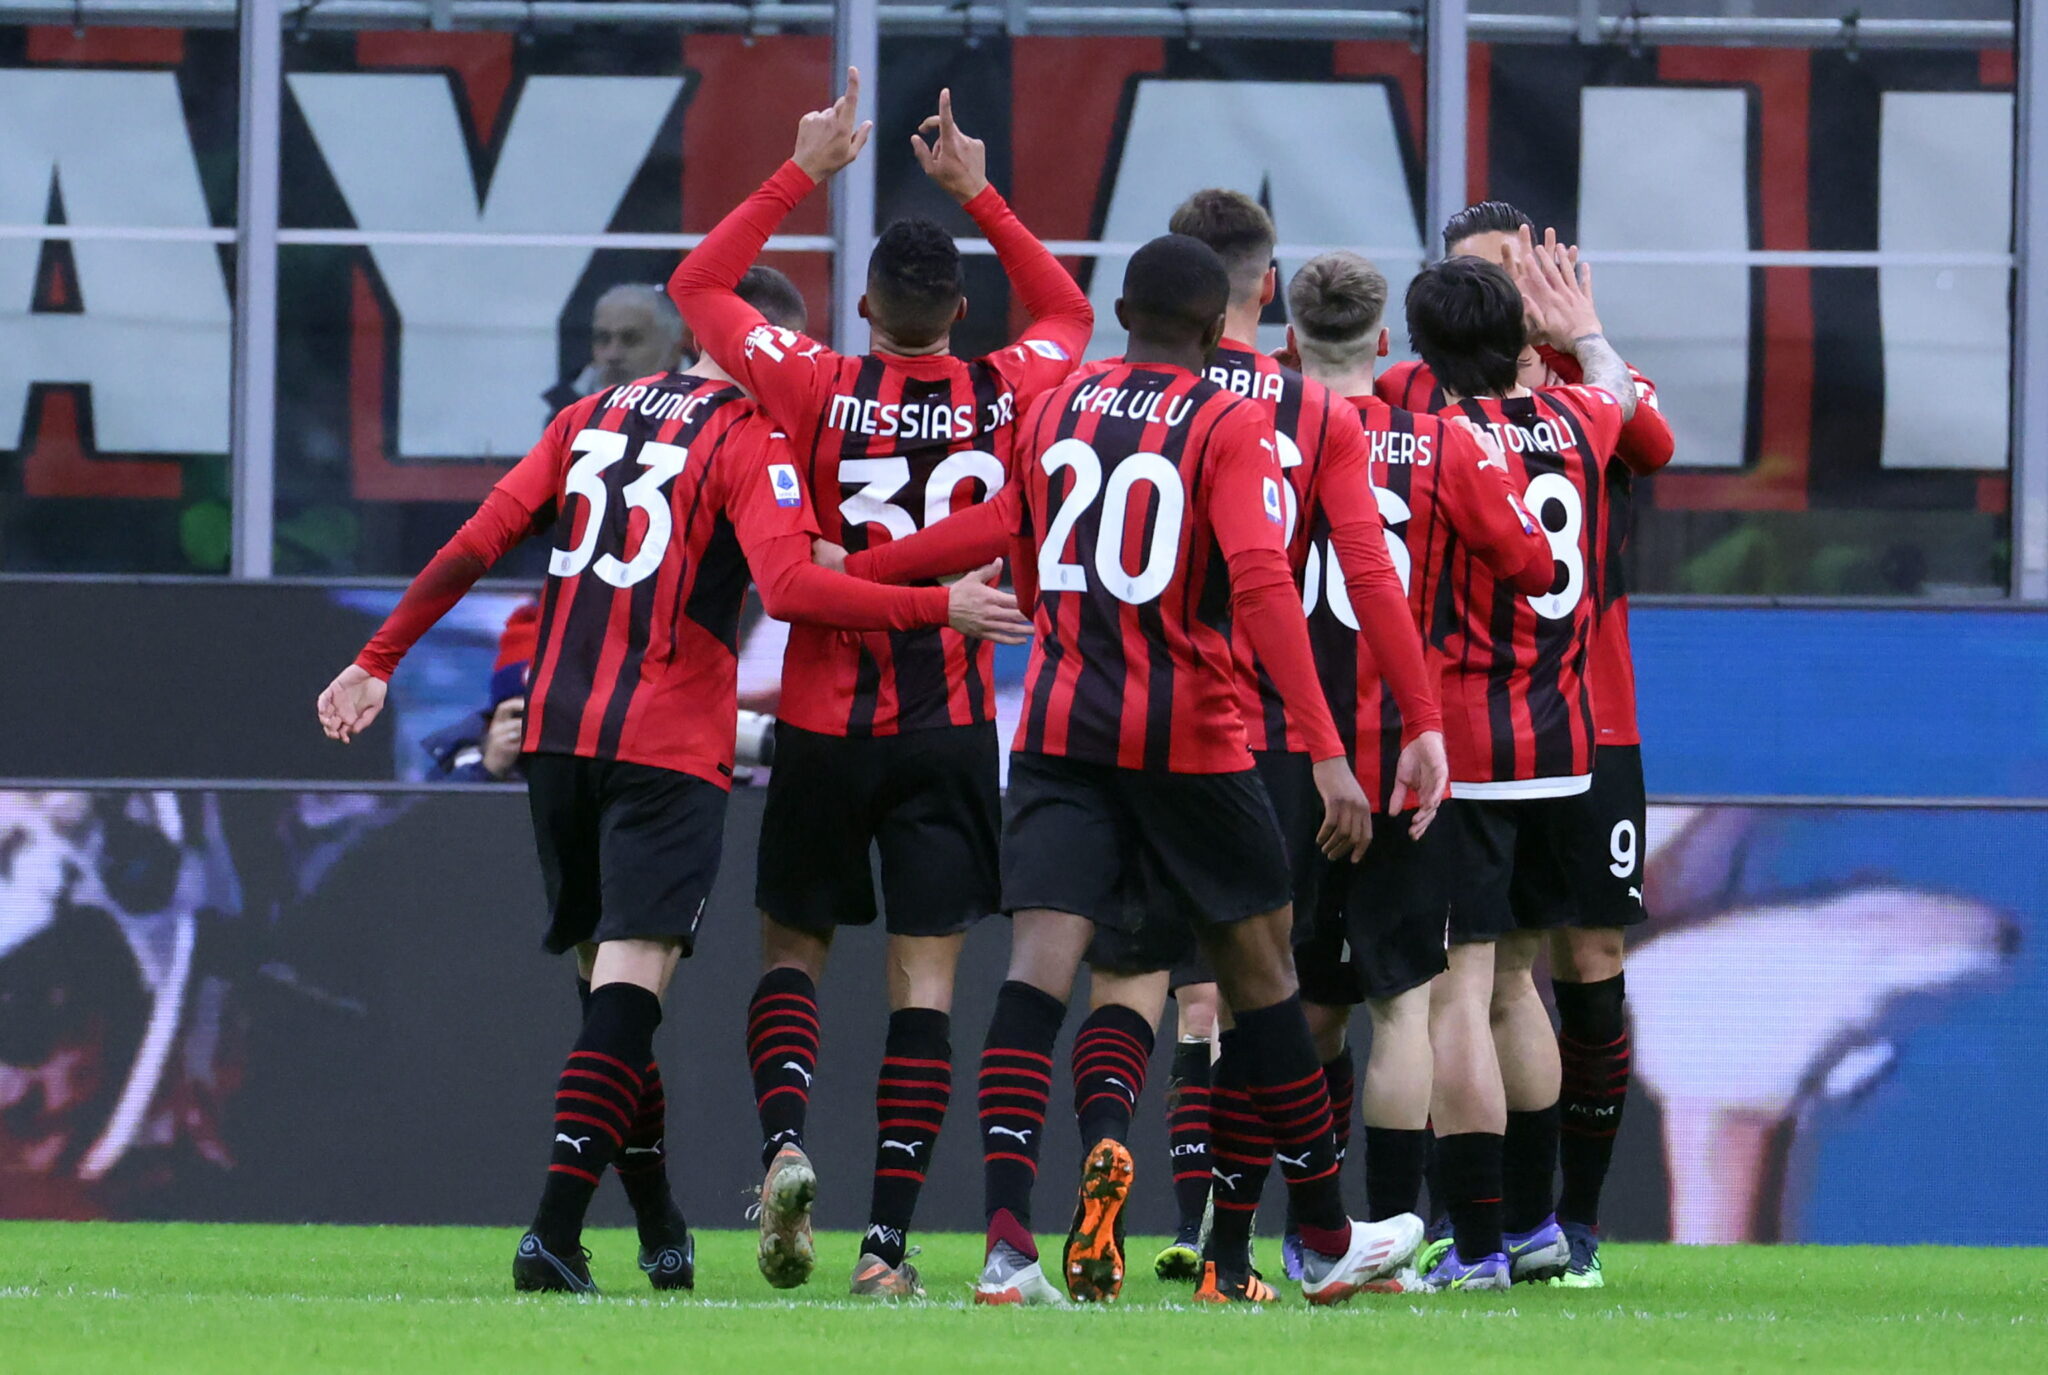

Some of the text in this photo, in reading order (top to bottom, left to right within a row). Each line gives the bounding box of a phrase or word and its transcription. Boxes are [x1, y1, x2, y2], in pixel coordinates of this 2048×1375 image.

[604, 385, 713, 424] KRUNIĆ
[828, 392, 1014, 439] MESSIAS JR
[1071, 384, 1193, 427] KALULU
[1364, 429, 1432, 467] KERS
[548, 429, 689, 588] 33
[1038, 438, 1185, 605] 20
[1302, 486, 1413, 632] 6
[1521, 472, 1583, 620] 8
[1609, 819, 1637, 879] 9
